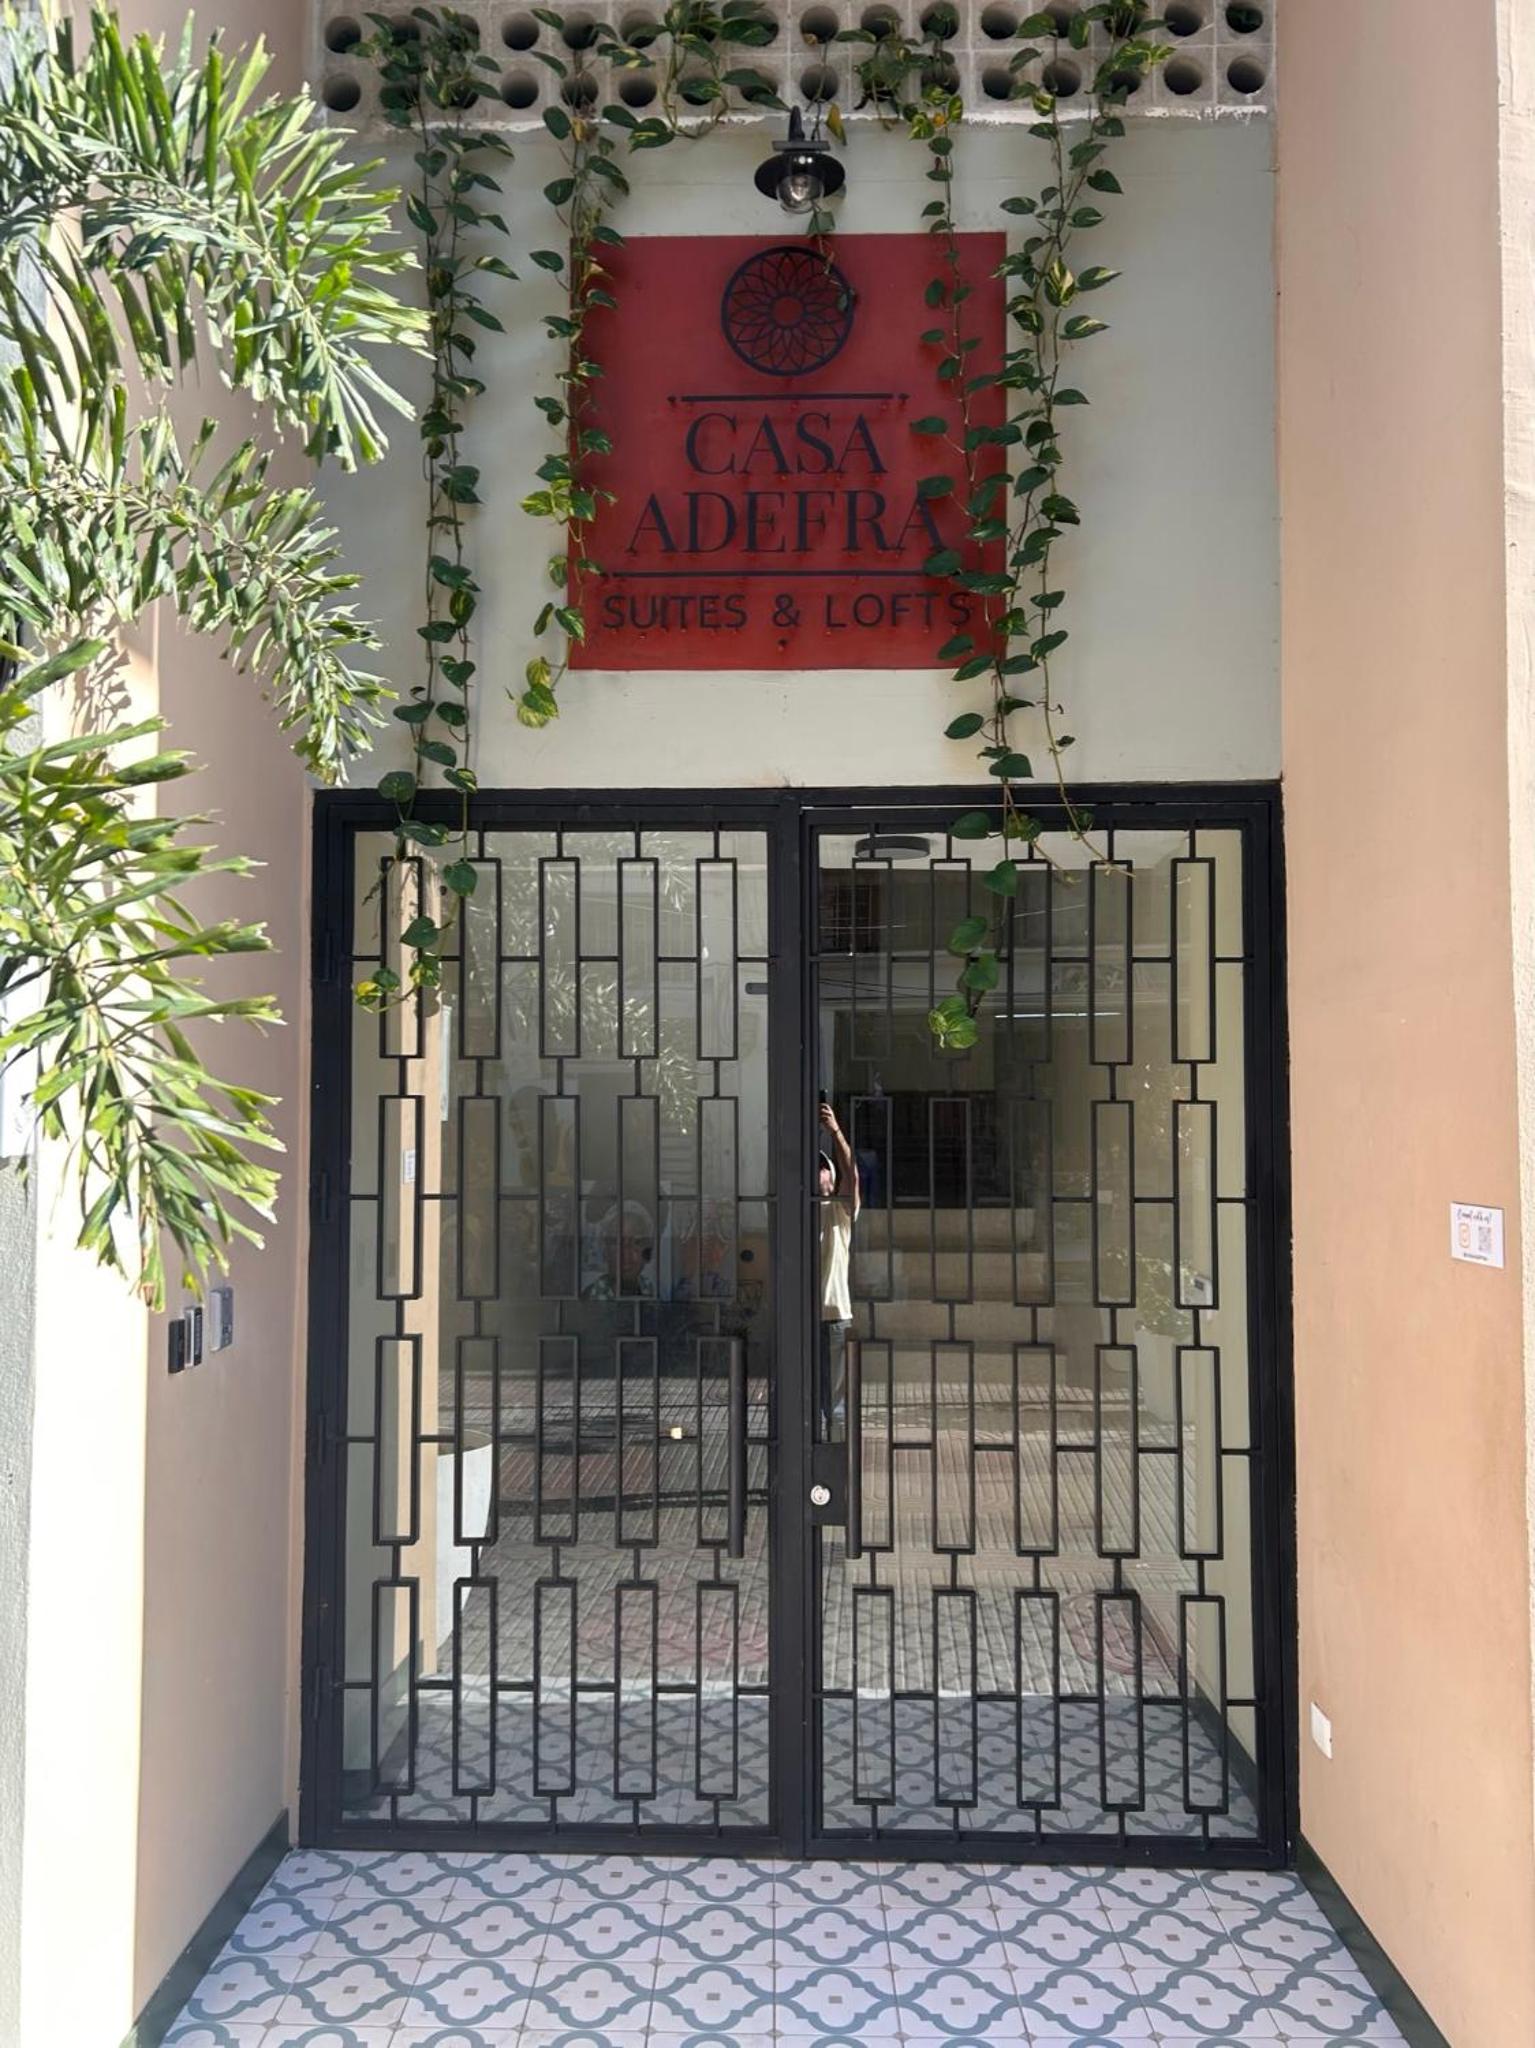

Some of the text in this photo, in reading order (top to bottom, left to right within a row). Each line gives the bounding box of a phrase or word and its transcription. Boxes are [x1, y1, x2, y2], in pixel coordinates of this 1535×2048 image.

[686, 413, 887, 475] CASA
[628, 489, 950, 555] ADEFRA
[603, 592, 972, 629] SUITES & LOFTS
